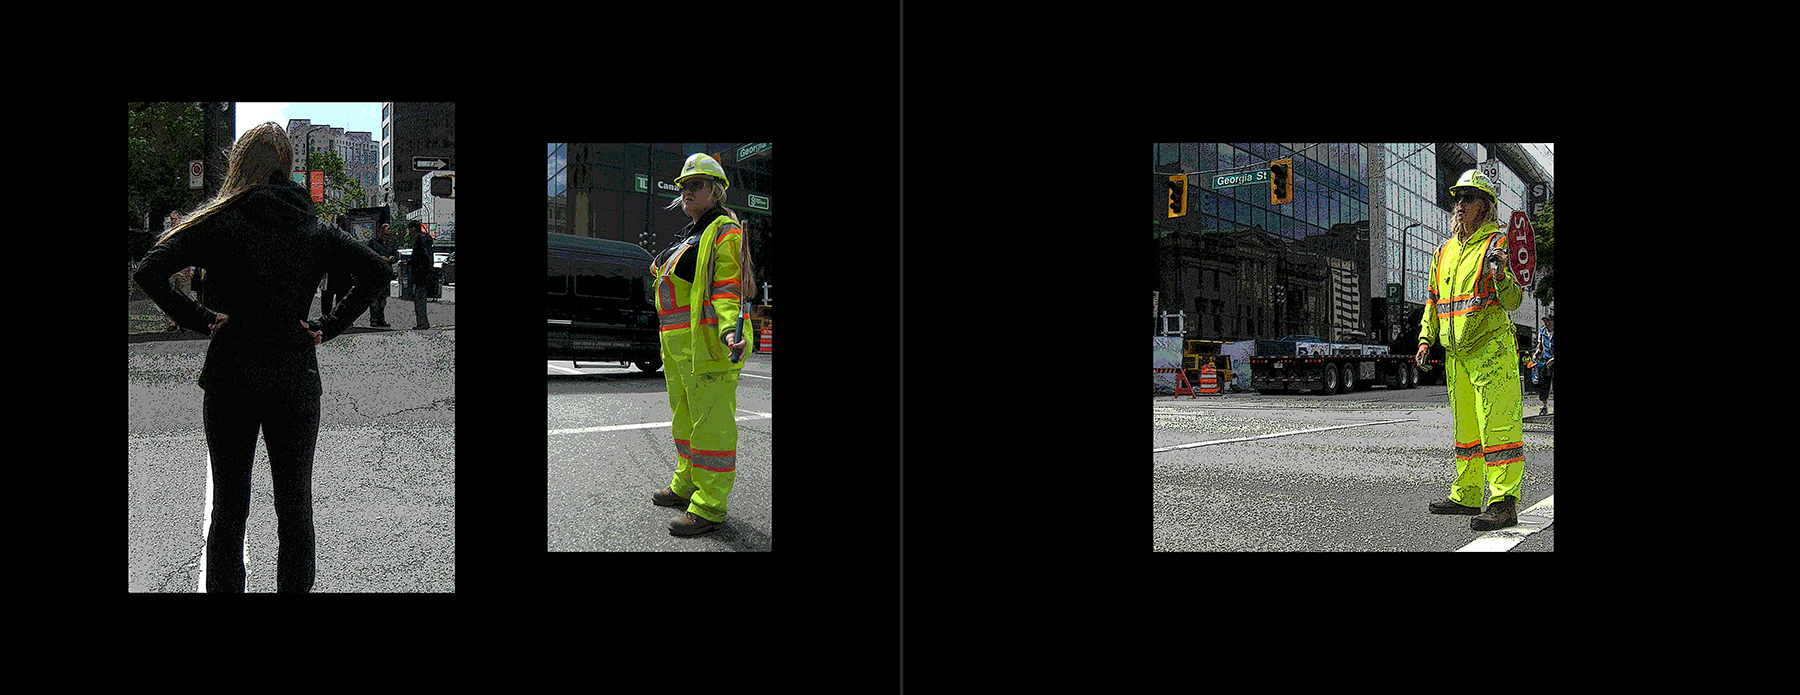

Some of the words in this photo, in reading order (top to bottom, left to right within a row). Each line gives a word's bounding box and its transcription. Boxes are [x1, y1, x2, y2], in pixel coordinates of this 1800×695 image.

[1217, 173, 1253, 185] Georgia
[1256, 171, 1267, 181] St
[1483, 168, 1497, 178] 99
[657, 180, 680, 192] Cana
[1514, 216, 1530, 282] STOP
[1389, 286, 1398, 297] P
